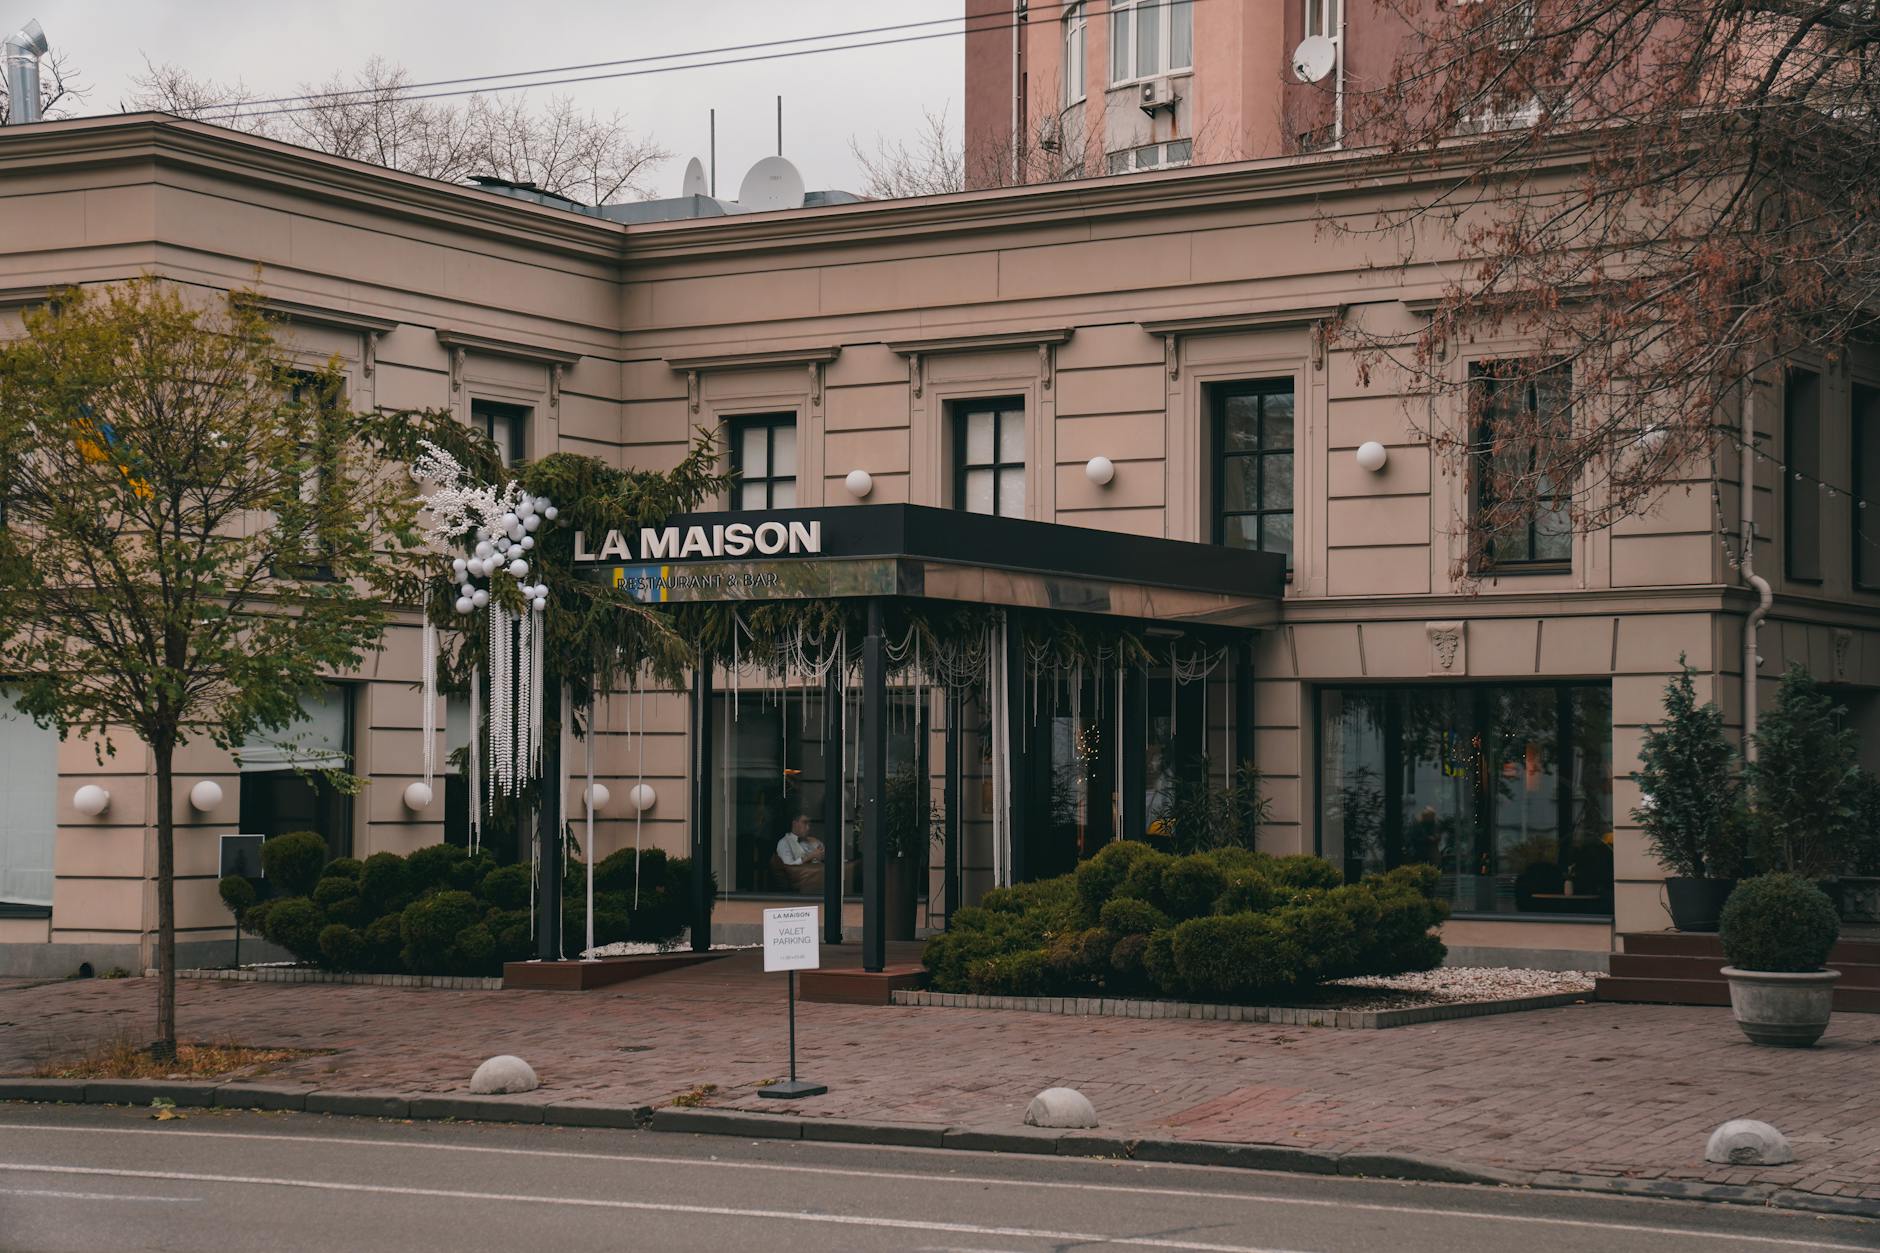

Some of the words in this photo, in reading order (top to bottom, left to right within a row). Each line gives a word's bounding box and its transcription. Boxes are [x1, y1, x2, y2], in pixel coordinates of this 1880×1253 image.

[574, 529, 632, 562] LA
[640, 521, 821, 559] MAISON
[617, 574, 721, 592] RESTAURANT
[728, 574, 739, 587] &
[743, 572, 779, 587] BAR
[779, 927, 804, 936] VALET
[773, 936, 811, 945] PARKING
